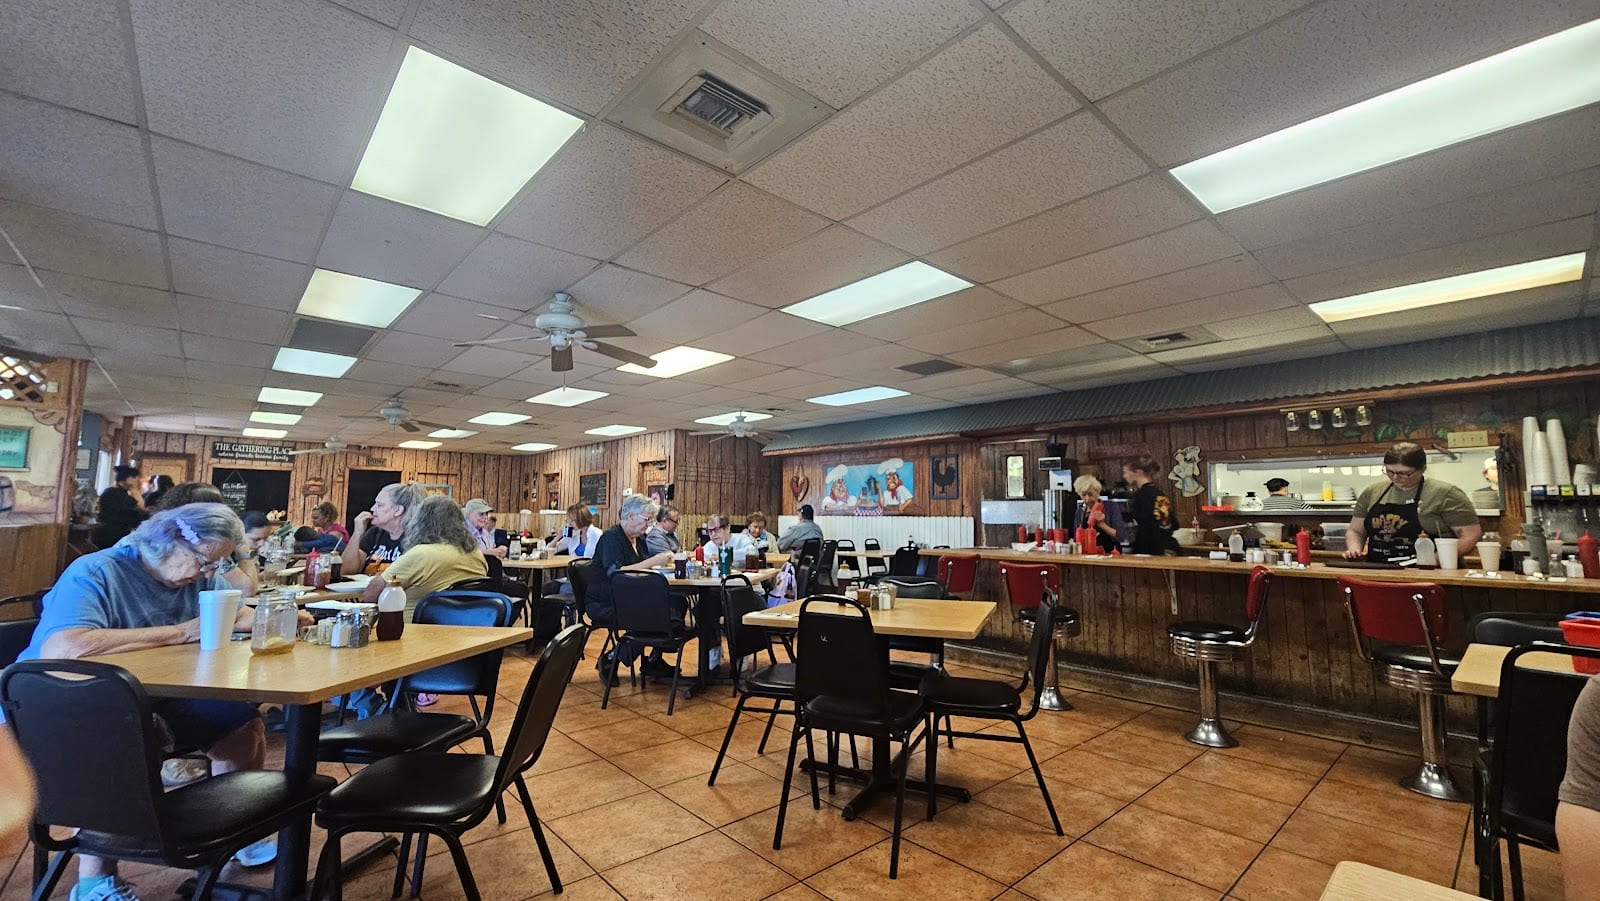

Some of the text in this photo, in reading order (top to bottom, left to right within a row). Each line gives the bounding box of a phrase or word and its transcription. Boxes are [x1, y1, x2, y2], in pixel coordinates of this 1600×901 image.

[215, 443, 231, 451] THE
[232, 444, 272, 453] GATHERING
[273, 454, 289, 462] family
